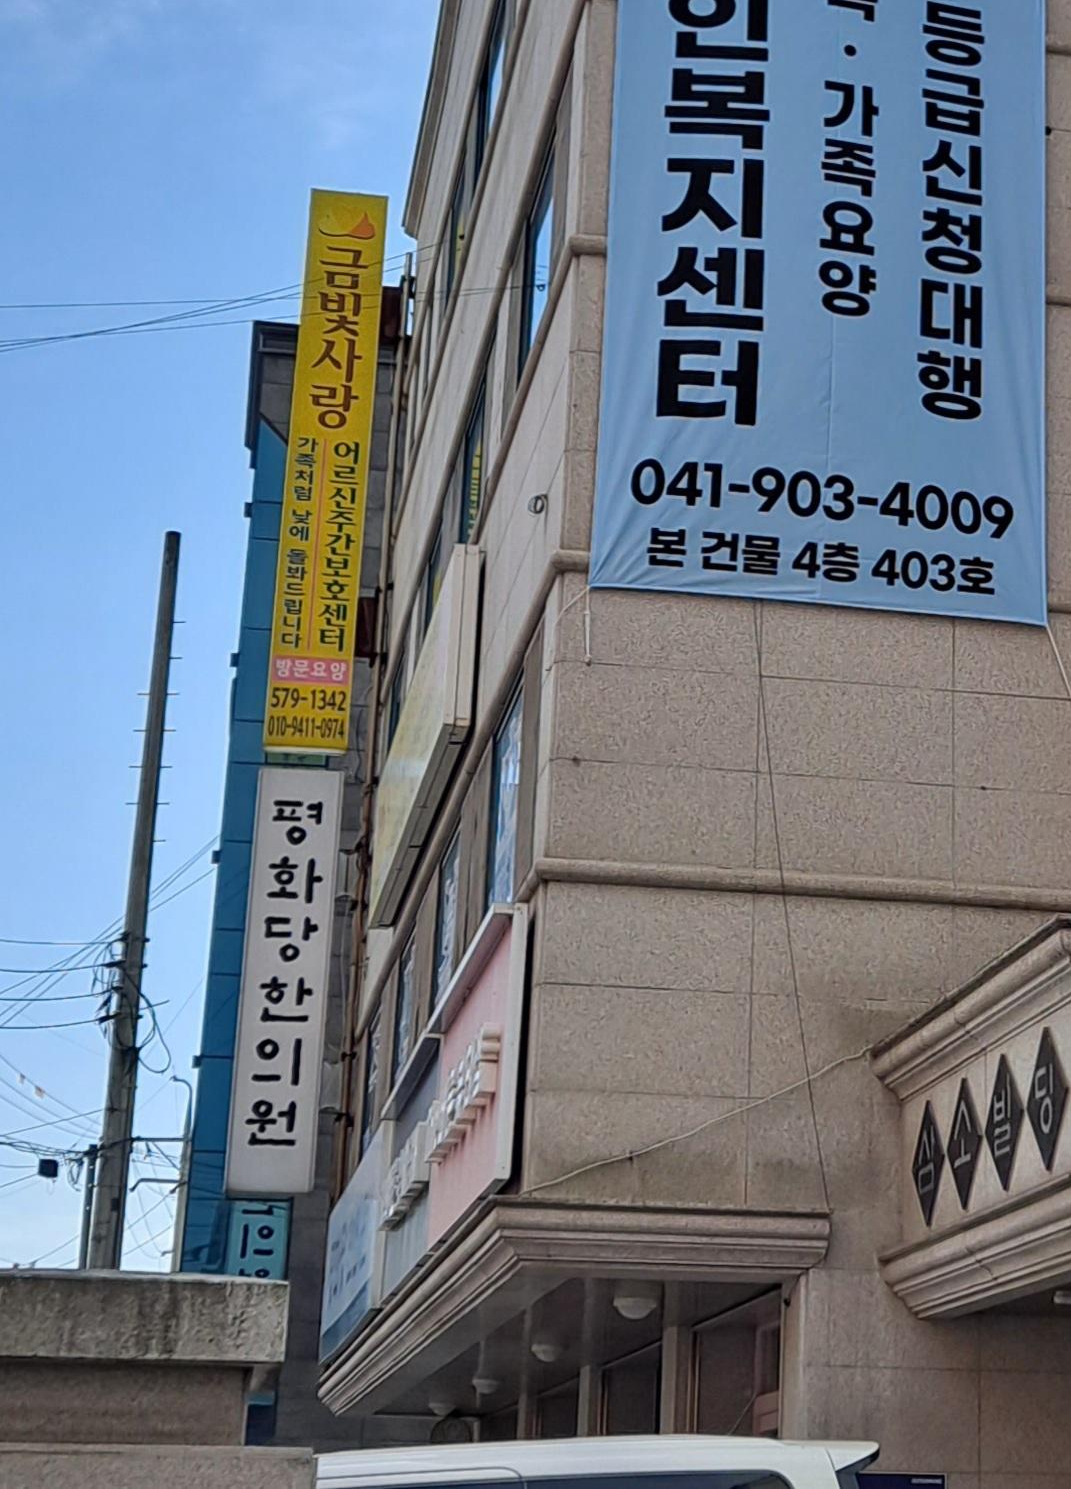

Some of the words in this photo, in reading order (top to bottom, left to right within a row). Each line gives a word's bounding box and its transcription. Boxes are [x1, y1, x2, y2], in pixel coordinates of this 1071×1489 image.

[818, 80, 880, 317] 가족요양
[917, 0, 986, 421] 등급신청대행
[309, 245, 369, 429] 금빛사랑
[293, 437, 319, 502] 가족처럼
[630, 457, 1015, 540] 041-903-4009
[318, 441, 360, 653] 어르신주간보호센터
[645, 527, 687, 568] 본
[700, 530, 781, 576] 건물
[791, 542, 861, 583] 4층
[871, 549, 996, 597] 403호
[270, 687, 347, 712] 579-1342
[275, 658, 347, 681] 방문요양
[245, 800, 324, 1147] 평화당한의원
